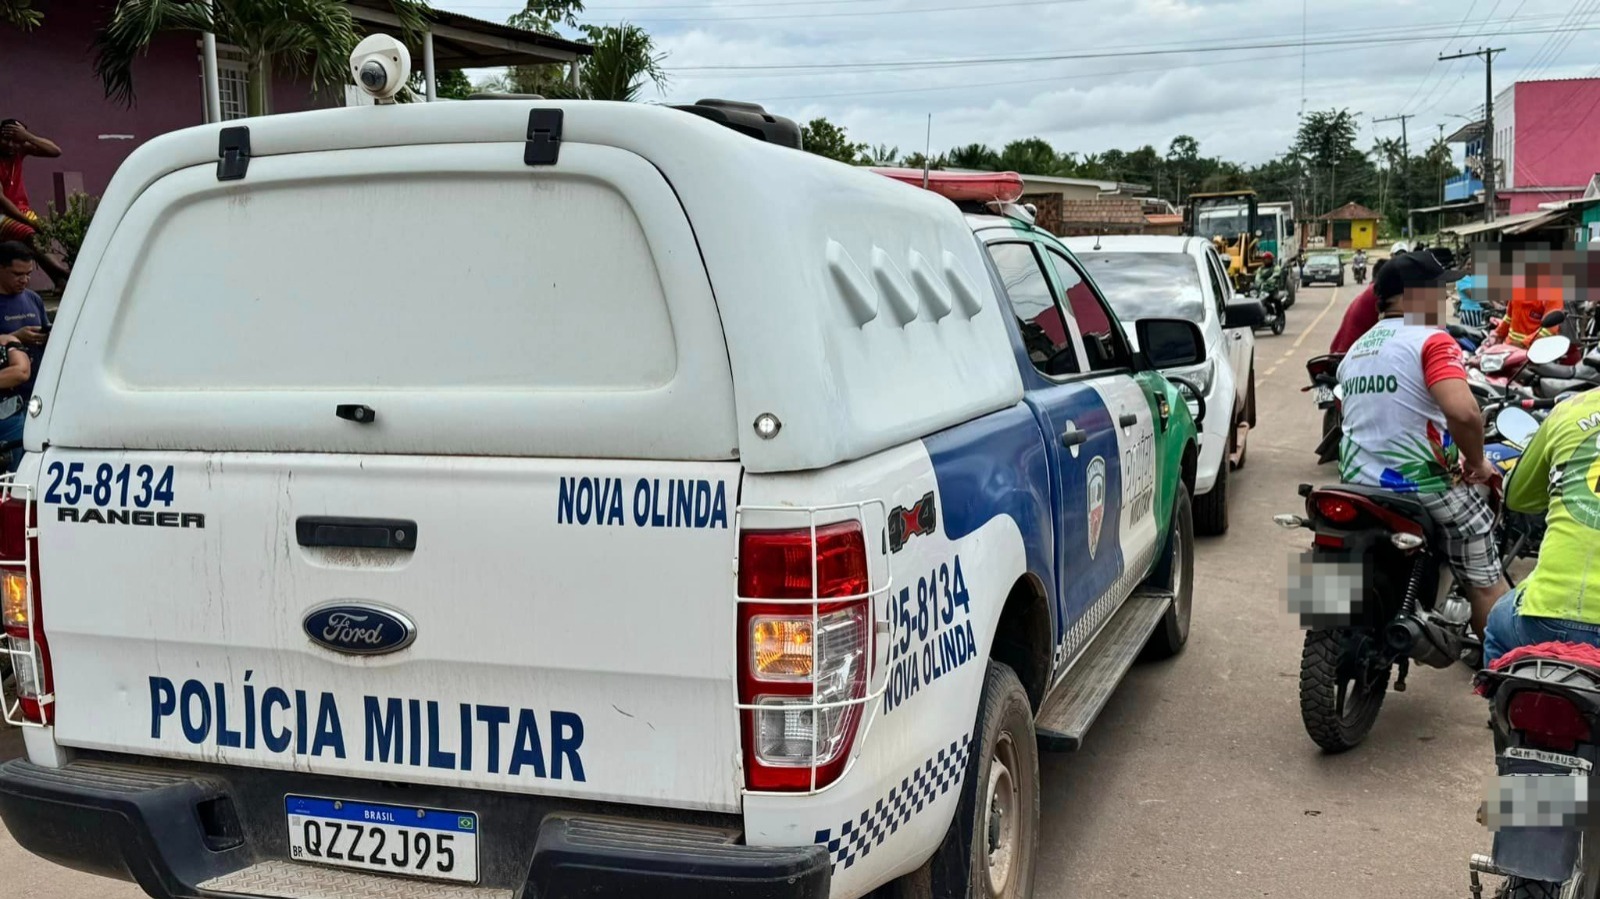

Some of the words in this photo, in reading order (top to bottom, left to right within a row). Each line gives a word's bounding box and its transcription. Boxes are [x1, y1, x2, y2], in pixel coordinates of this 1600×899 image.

[44, 460, 175, 508] 25-8134
[557, 476, 625, 527] NOVA
[633, 477, 728, 529] OLINDA
[57, 506, 205, 529] RANGER
[323, 612, 383, 643] Ford
[884, 651, 920, 715] NOVA
[923, 619, 977, 685] OLINDA
[149, 670, 347, 760] POLÍCIA
[363, 695, 587, 783] MILITAR
[364, 810, 395, 822] BRASIL
[292, 845, 304, 858] BR
[304, 819, 455, 873] QZZ2J95
